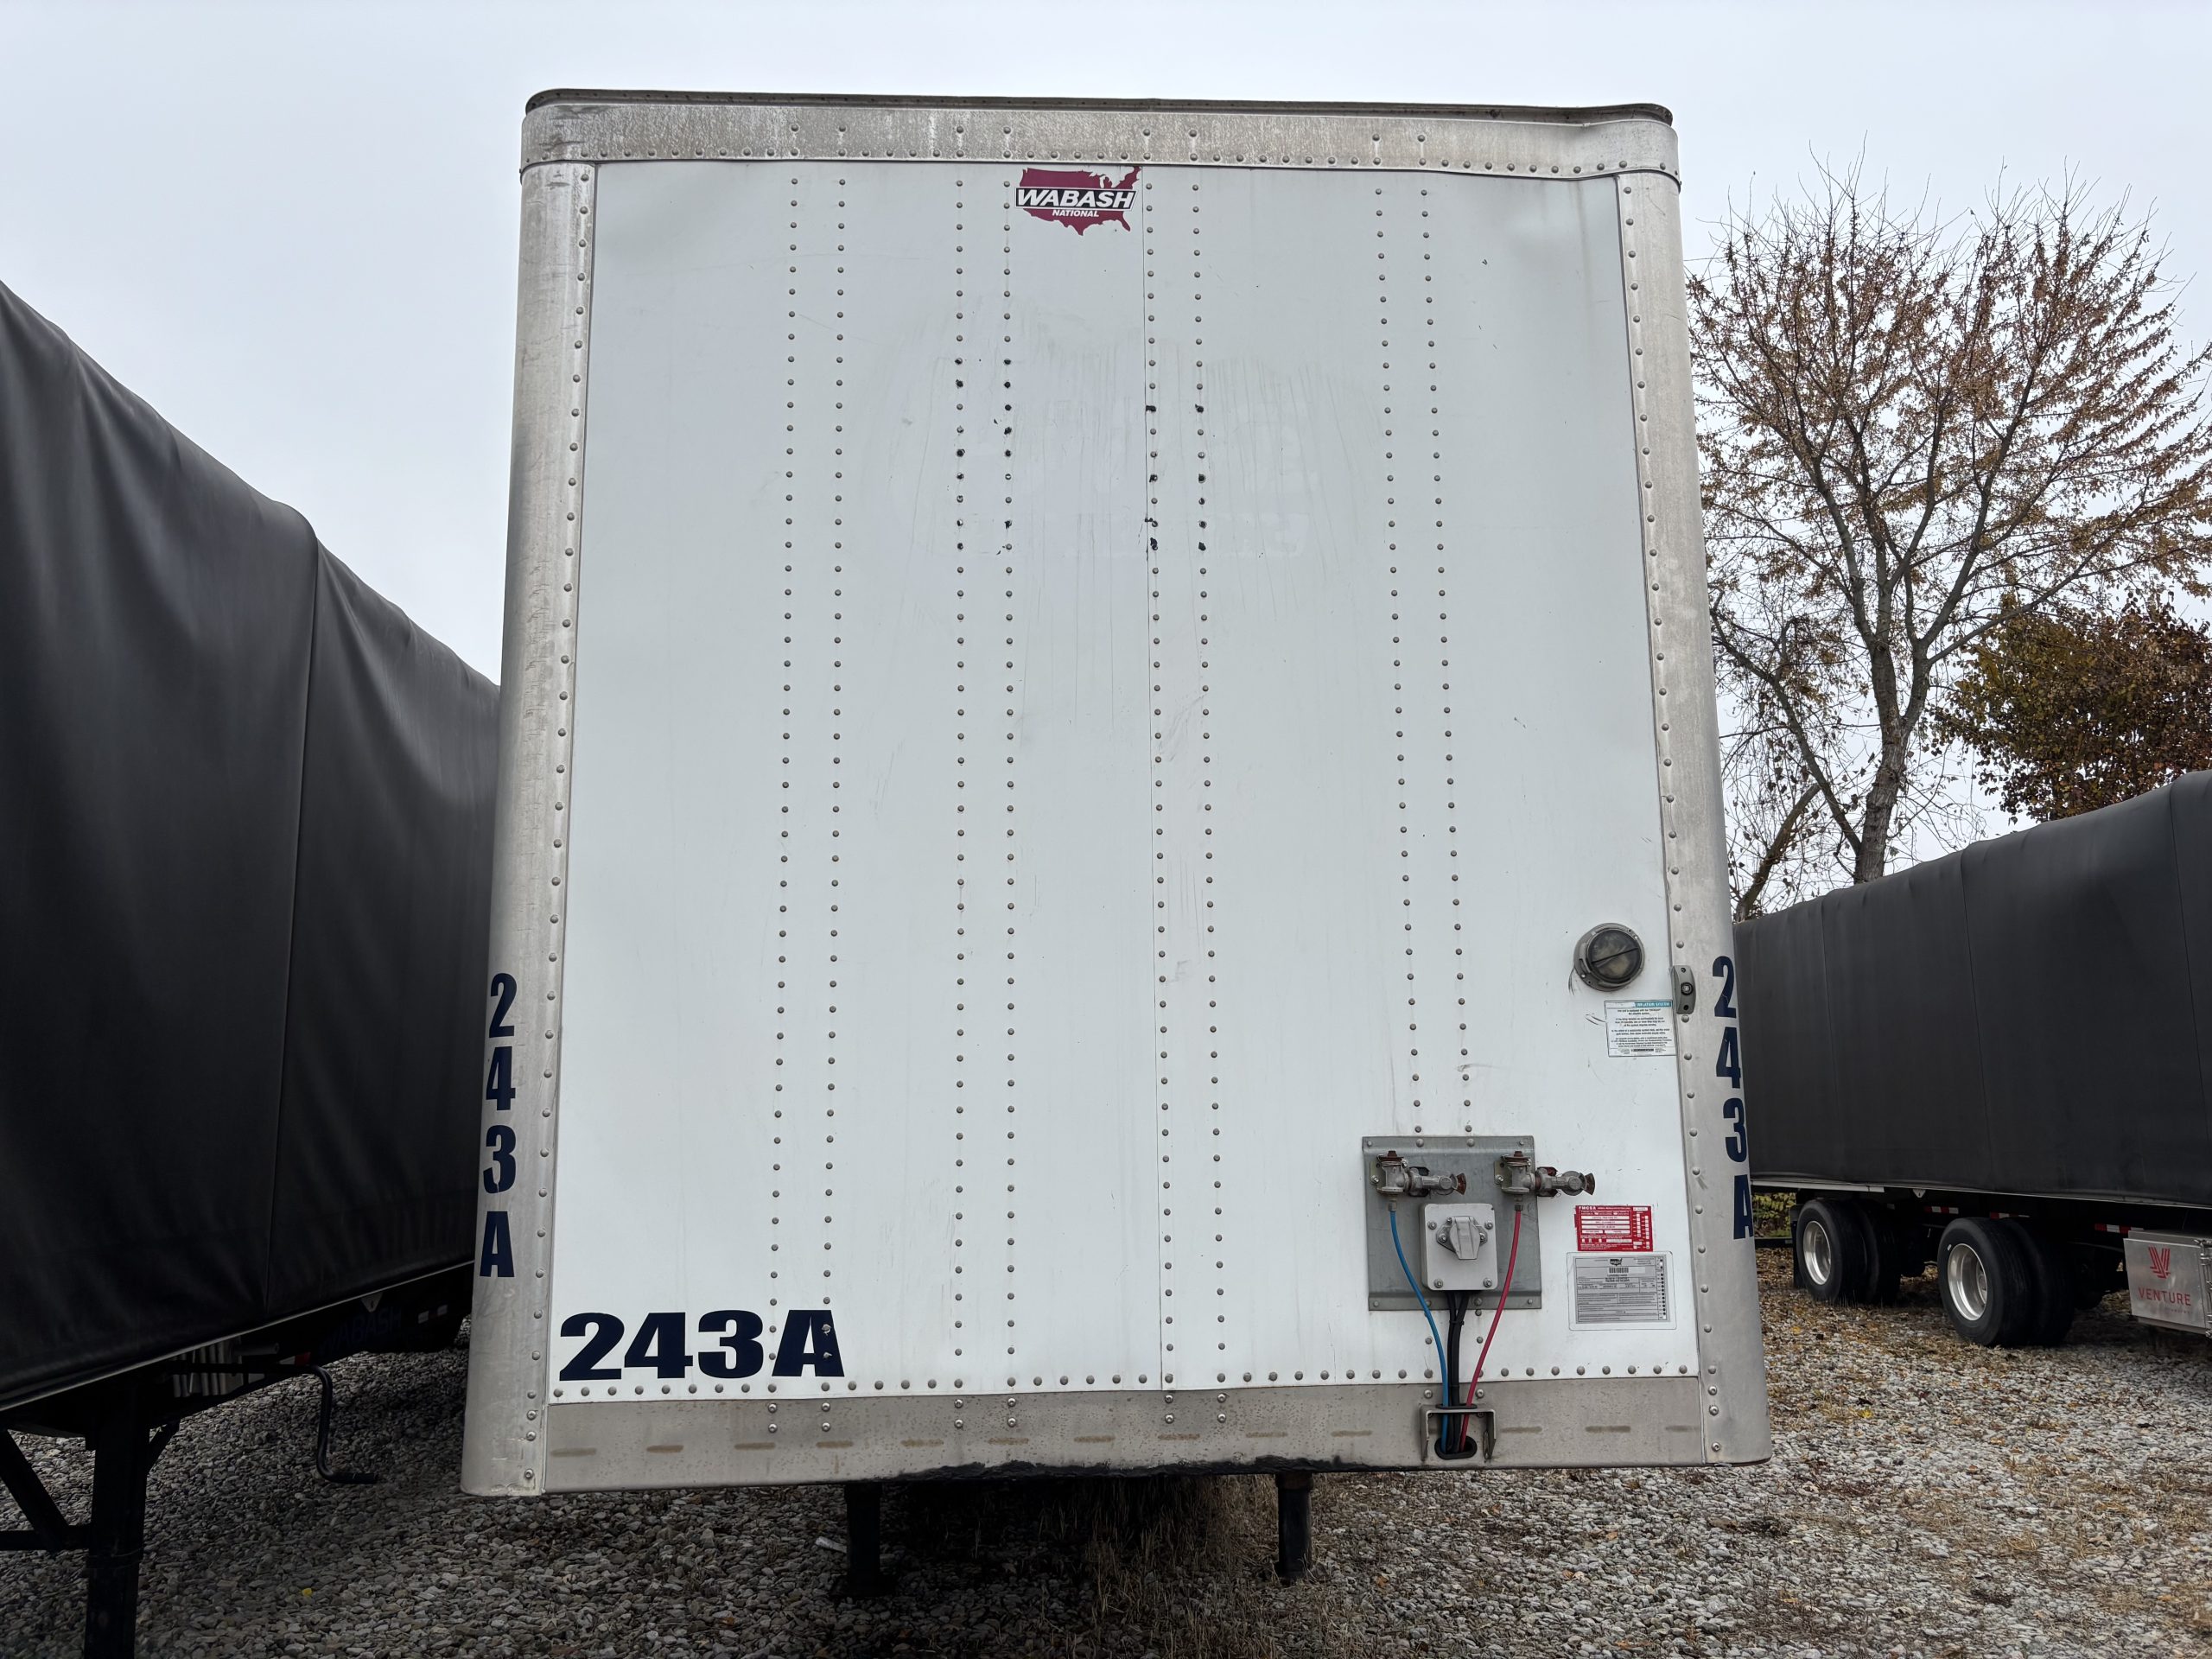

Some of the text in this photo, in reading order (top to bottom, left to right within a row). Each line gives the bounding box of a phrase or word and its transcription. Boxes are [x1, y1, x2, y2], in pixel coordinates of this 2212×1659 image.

[1018, 188, 1135, 208] WABASH
[480, 972, 518, 1278] 243A
[1713, 955, 1753, 1240] 243A
[2137, 1287, 2192, 1306] VENTURE
[559, 1309, 845, 1382] 243A
